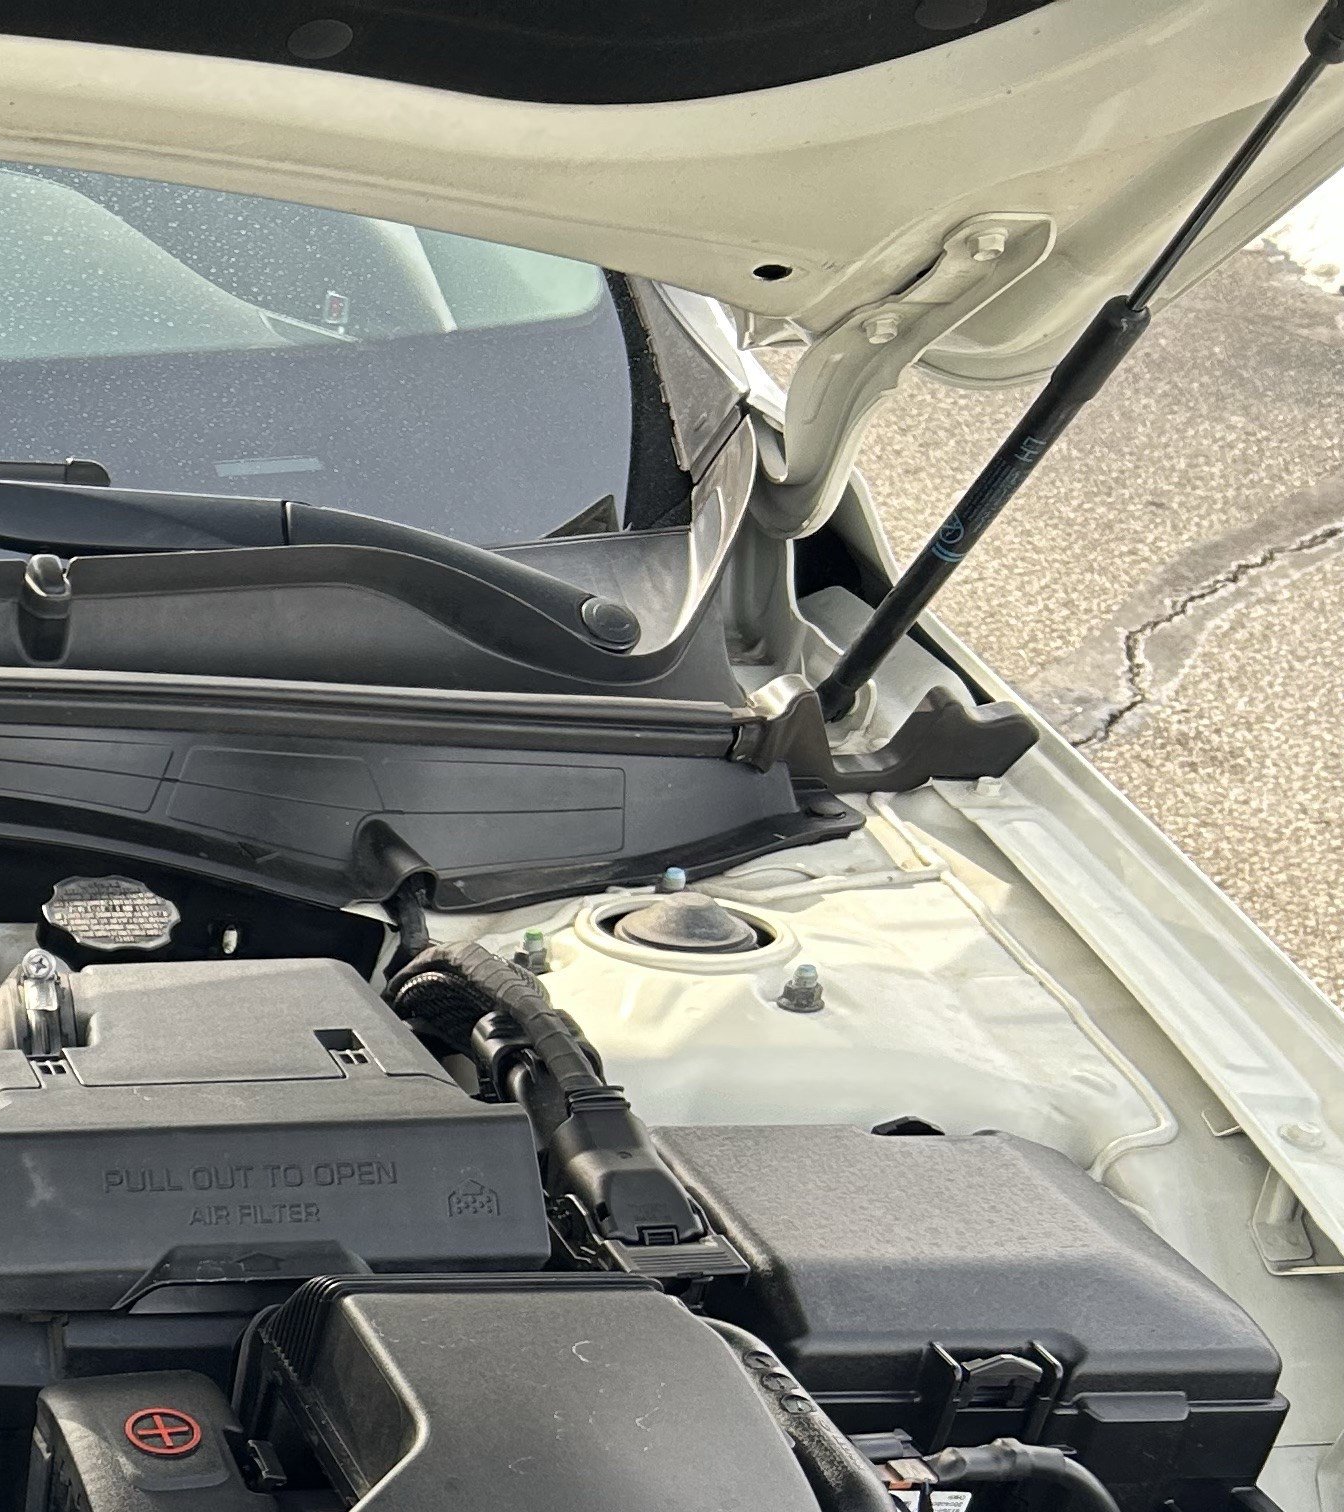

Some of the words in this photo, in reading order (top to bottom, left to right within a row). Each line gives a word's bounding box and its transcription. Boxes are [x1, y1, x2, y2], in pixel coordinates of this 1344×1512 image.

[103, 1168, 183, 1194] PULL
[189, 1164, 255, 1190] OUT
[263, 1164, 304, 1188] TO
[313, 1161, 398, 1187] OPEN
[188, 1204, 230, 1226] AIR
[238, 1202, 321, 1225] FILTER
